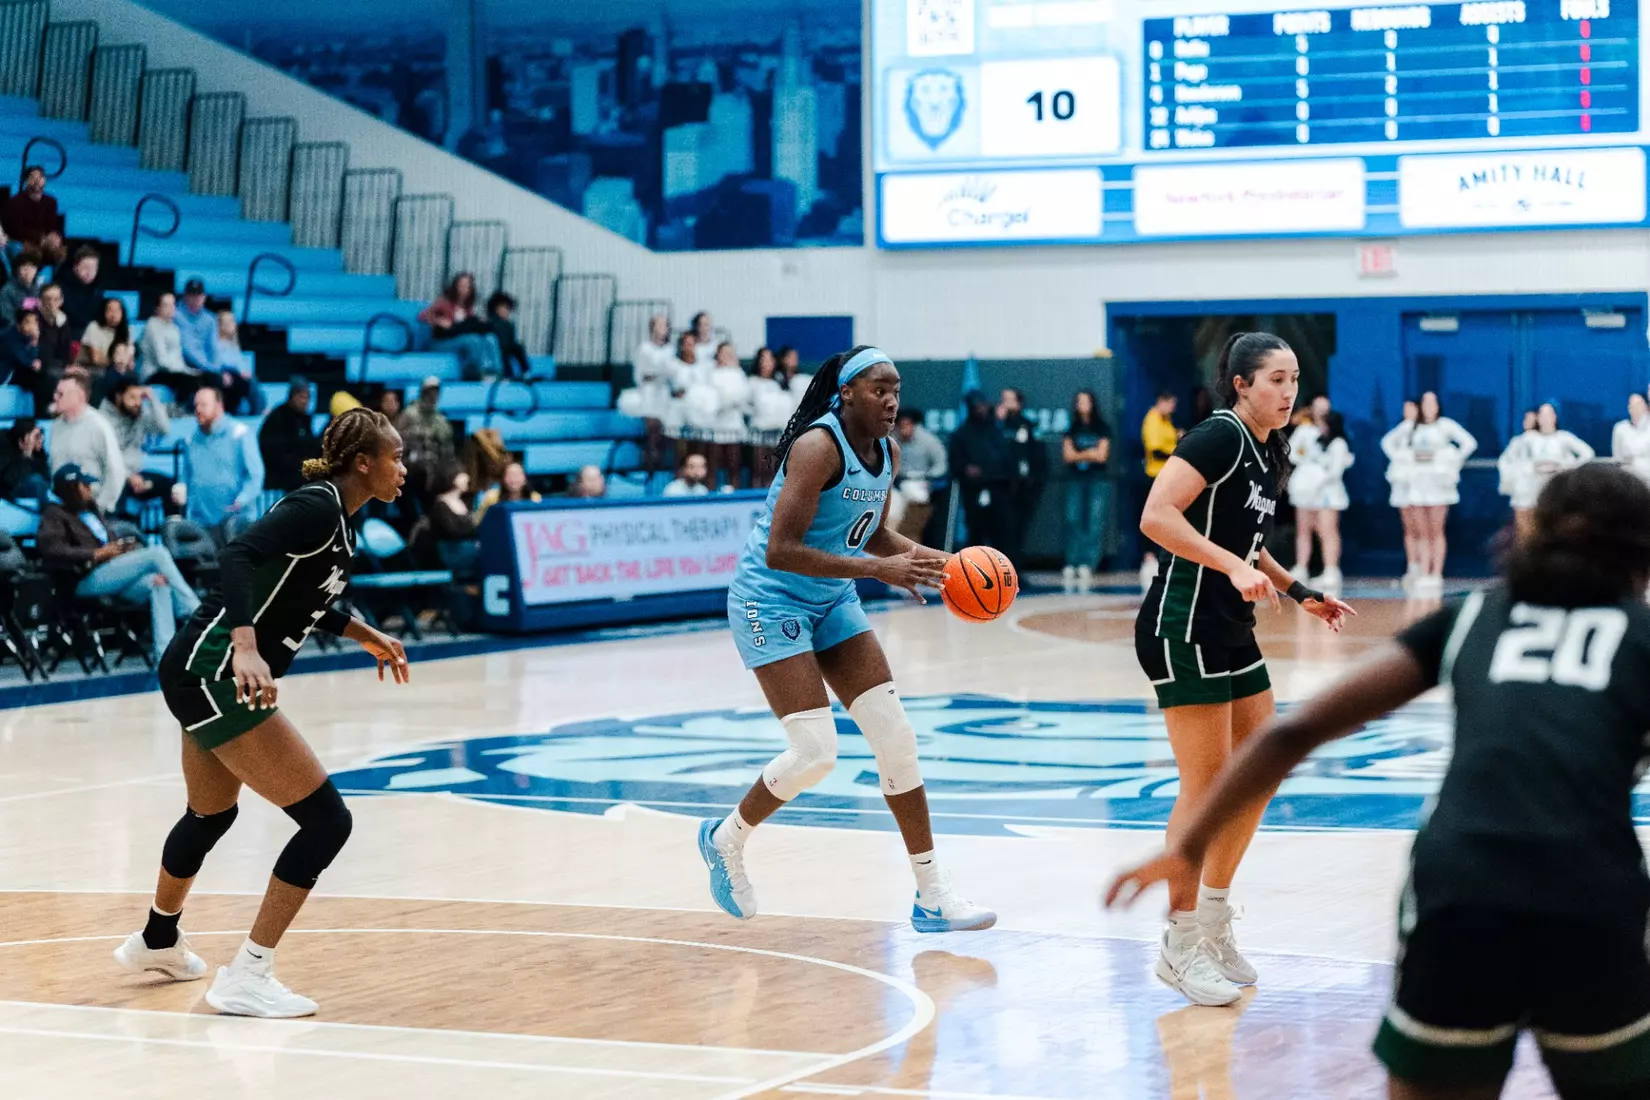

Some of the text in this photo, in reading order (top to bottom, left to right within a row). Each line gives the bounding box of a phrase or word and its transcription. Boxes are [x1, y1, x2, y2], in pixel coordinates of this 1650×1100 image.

[1026, 91, 1076, 121] 10
[1458, 164, 1585, 191] AMITY HALL
[589, 520, 669, 547] PHYSICAL
[671, 516, 740, 541] THERAPY
[846, 509, 876, 549] 0
[1488, 602, 1629, 692] 20
